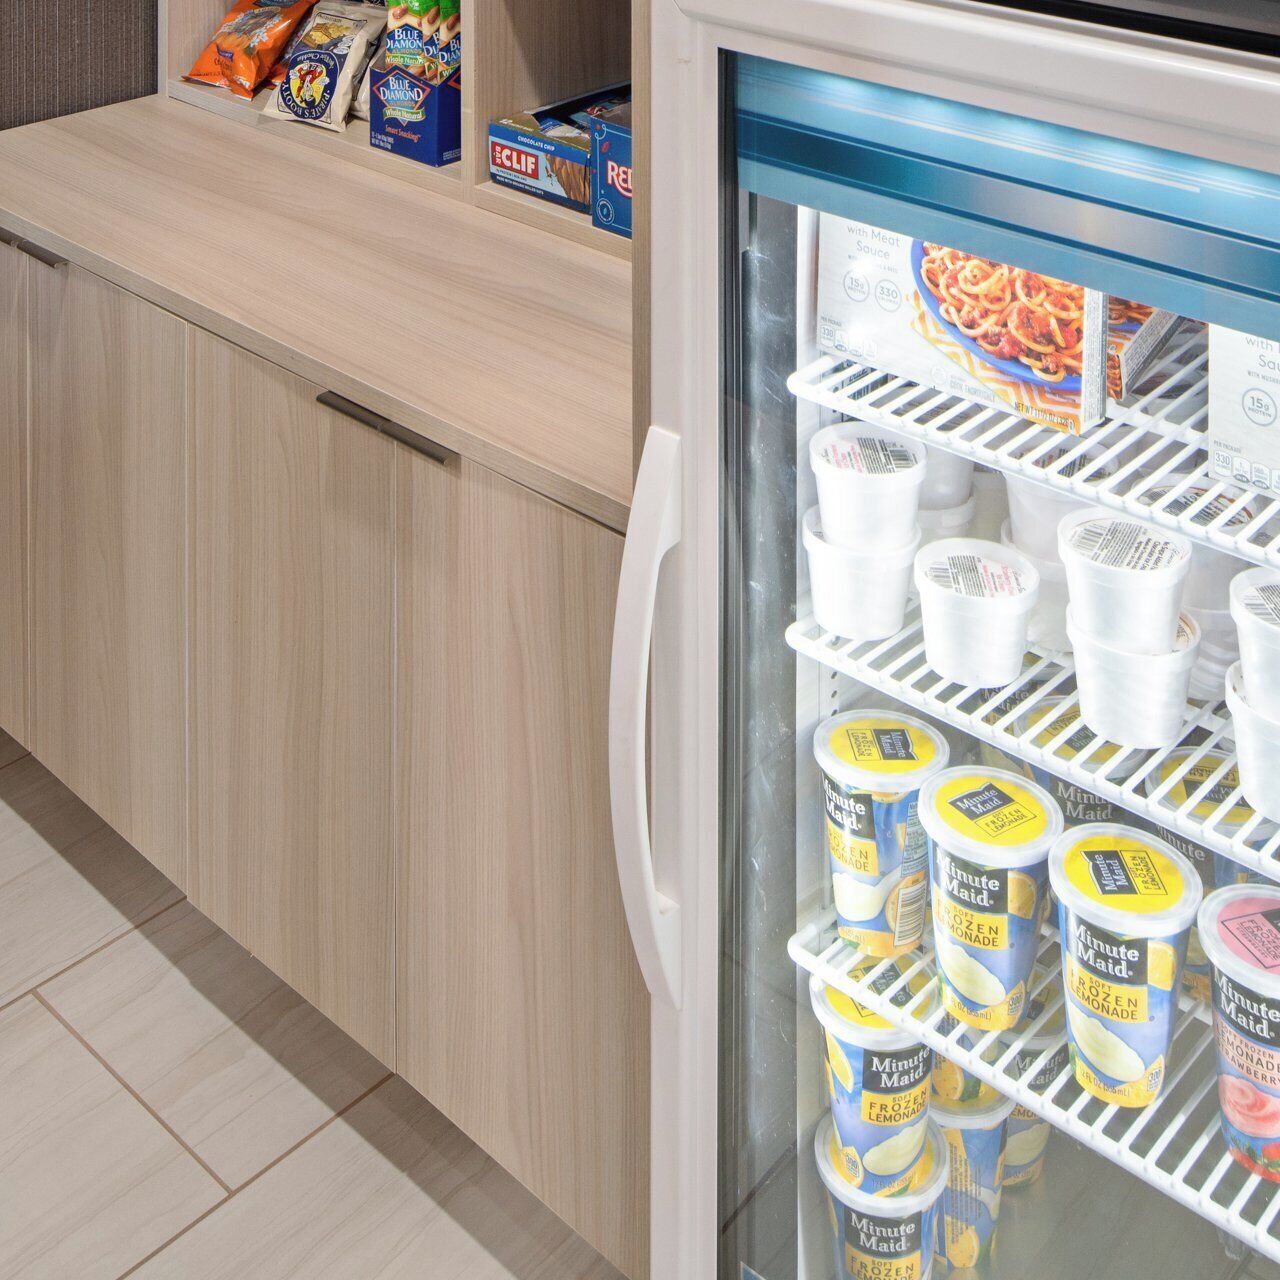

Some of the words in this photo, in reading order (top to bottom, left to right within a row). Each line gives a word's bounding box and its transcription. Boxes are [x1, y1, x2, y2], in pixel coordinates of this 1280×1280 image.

[394, 28, 419, 40] BLUE
[386, 56, 404, 64] Whole
[389, 78, 410, 90] BLUE
[282, 82, 302, 116] BOOTY
[380, 88, 423, 101] DIAMOND
[304, 92, 330, 118] PIRATE'S
[386, 108, 402, 118] Whole
[402, 110, 422, 120] Natural
[386, 125, 398, 134] Smart
[398, 128, 418, 142] Snacking
[518, 135, 544, 148] CHOCOLATE
[501, 148, 536, 174] CLIF
[846, 224, 868, 238] with
[872, 231, 901, 248] Meat
[856, 240, 890, 259] Sauce
[847, 286, 866, 296] PROTEIN
[849, 277, 864, 290] 15g
[879, 286, 898, 298] 330
[1245, 336, 1273, 352] with
[1248, 406, 1272, 418] PROTEIN
[1250, 396, 1270, 412] 15g
[1214, 440, 1222, 448] PER
[1222, 442, 1242, 454] PACKAGE
[1215, 452, 1231, 466] 330
[956, 788, 998, 810] Minute
[970, 798, 1003, 816] Maid
[984, 808, 1022, 828] FROZEN
[1066, 801, 1112, 820] Maid
[990, 812, 1028, 834] LEMONADE
[936, 846, 1000, 892] Minute
[1095, 854, 1117, 891] Minute
[1112, 860, 1128, 891] Maid
[1130, 854, 1151, 890] FROZEN
[942, 875, 994, 907] Maid
[1072, 925, 1140, 962] Minute
[1075, 946, 1132, 978] Maid
[1220, 994, 1271, 1039] Maid
[872, 1047, 932, 1074] Minute
[880, 1068, 924, 1088] Maid
[850, 1212, 916, 1236] Minute
[859, 1230, 906, 1253] Maid
[851, 1255, 914, 1278] FROZEN
